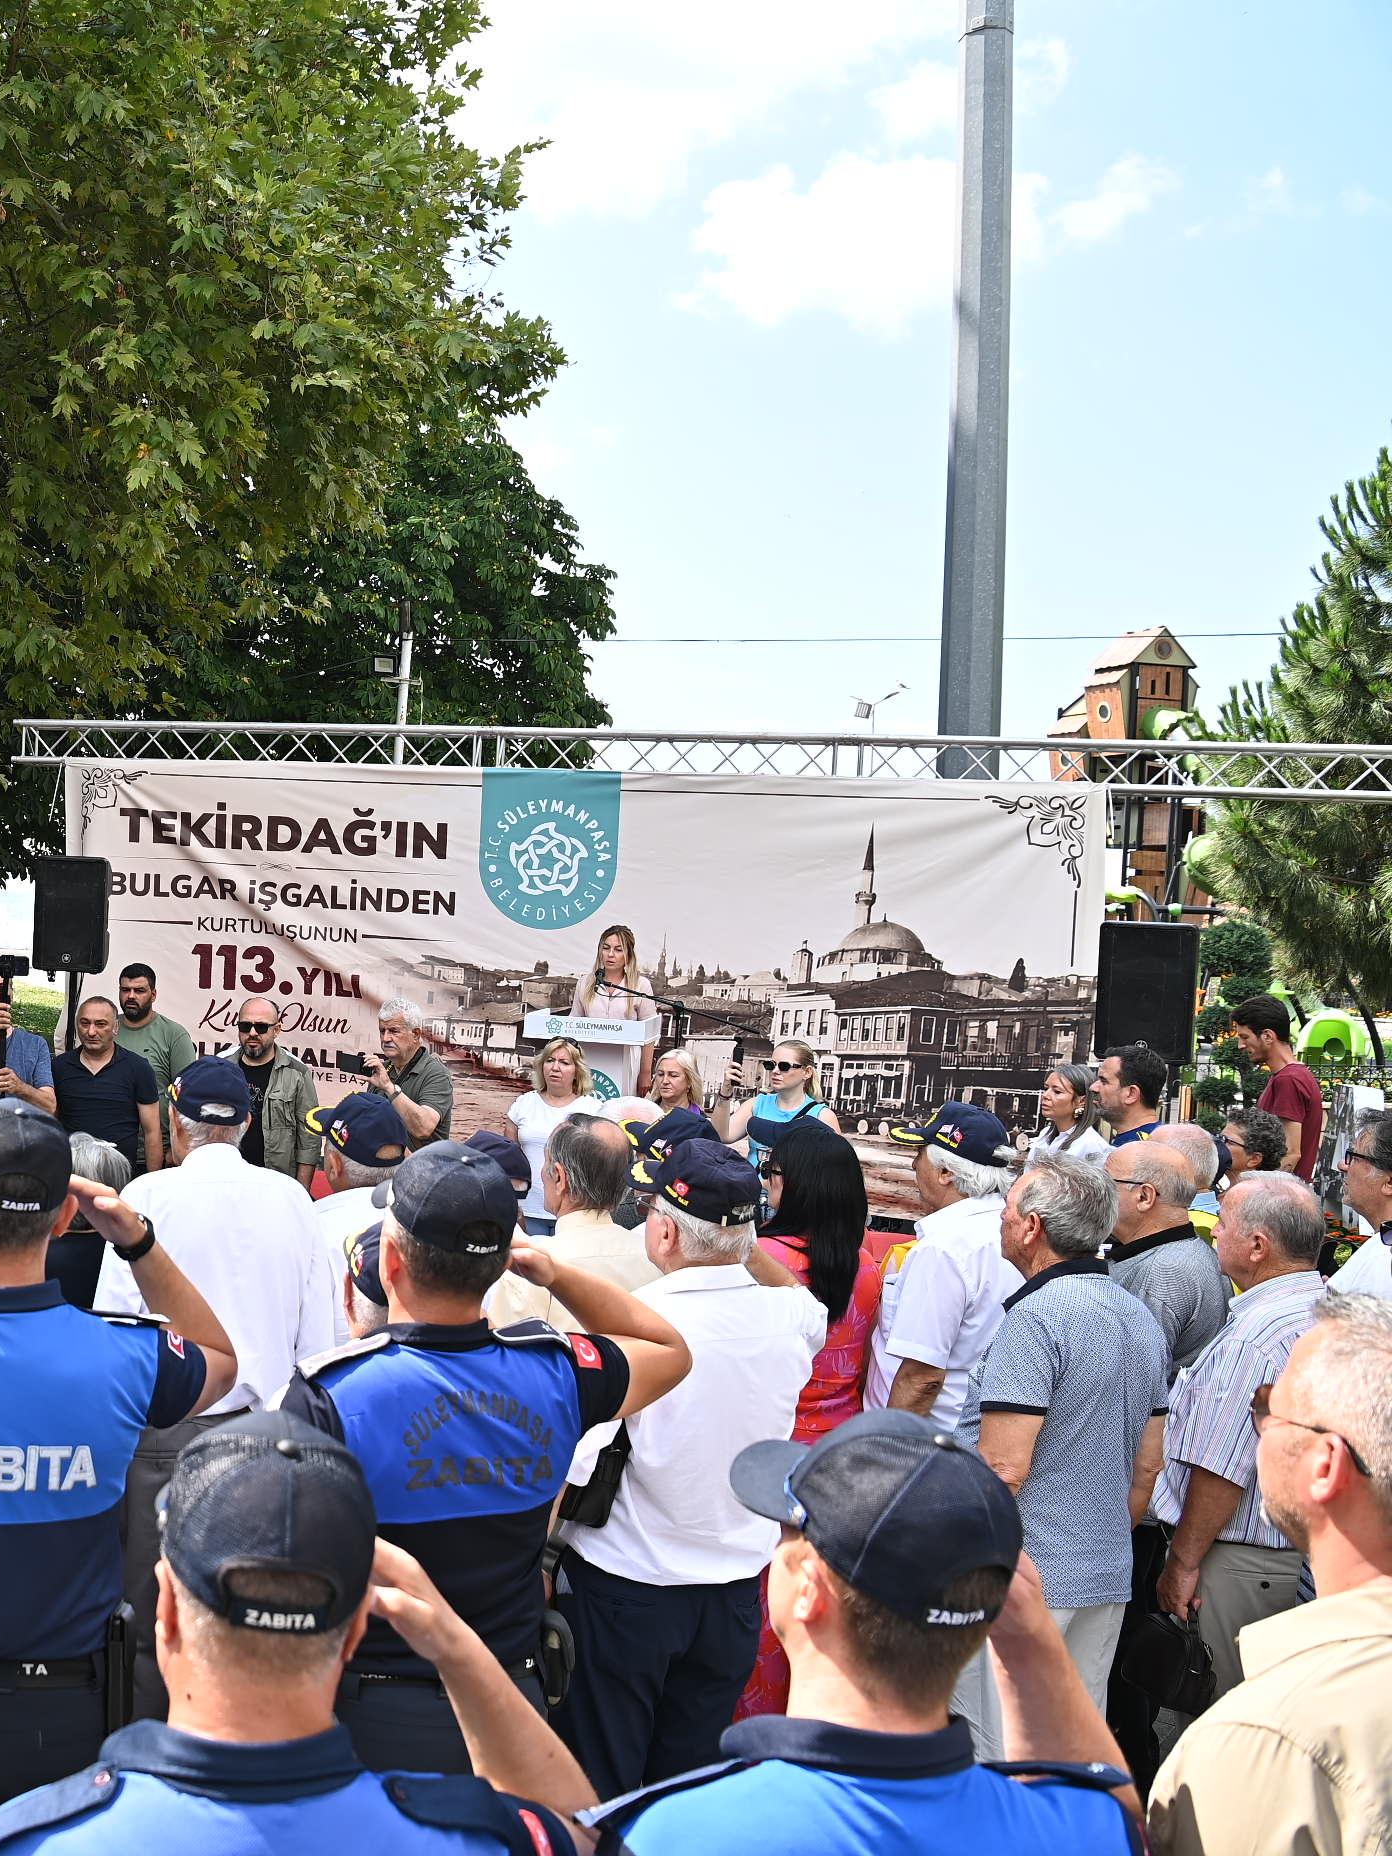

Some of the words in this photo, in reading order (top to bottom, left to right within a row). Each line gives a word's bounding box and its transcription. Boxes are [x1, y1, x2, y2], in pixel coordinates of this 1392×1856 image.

[120, 802, 449, 860] TEKİRDAĞ'IN
[497, 799, 612, 862] SÜLEYMANPAŞA
[110, 871, 240, 902] BULGAR
[490, 877, 604, 921] BELEDİYESİ
[196, 916, 358, 943] KURTULUŞUNUN
[191, 943, 294, 996] 113.
[1, 1200, 41, 1211] ZABITA
[406, 1455, 553, 1491] ZABITA
[244, 1608, 316, 1630] ZABITA
[926, 1608, 985, 1625] ZABITA
